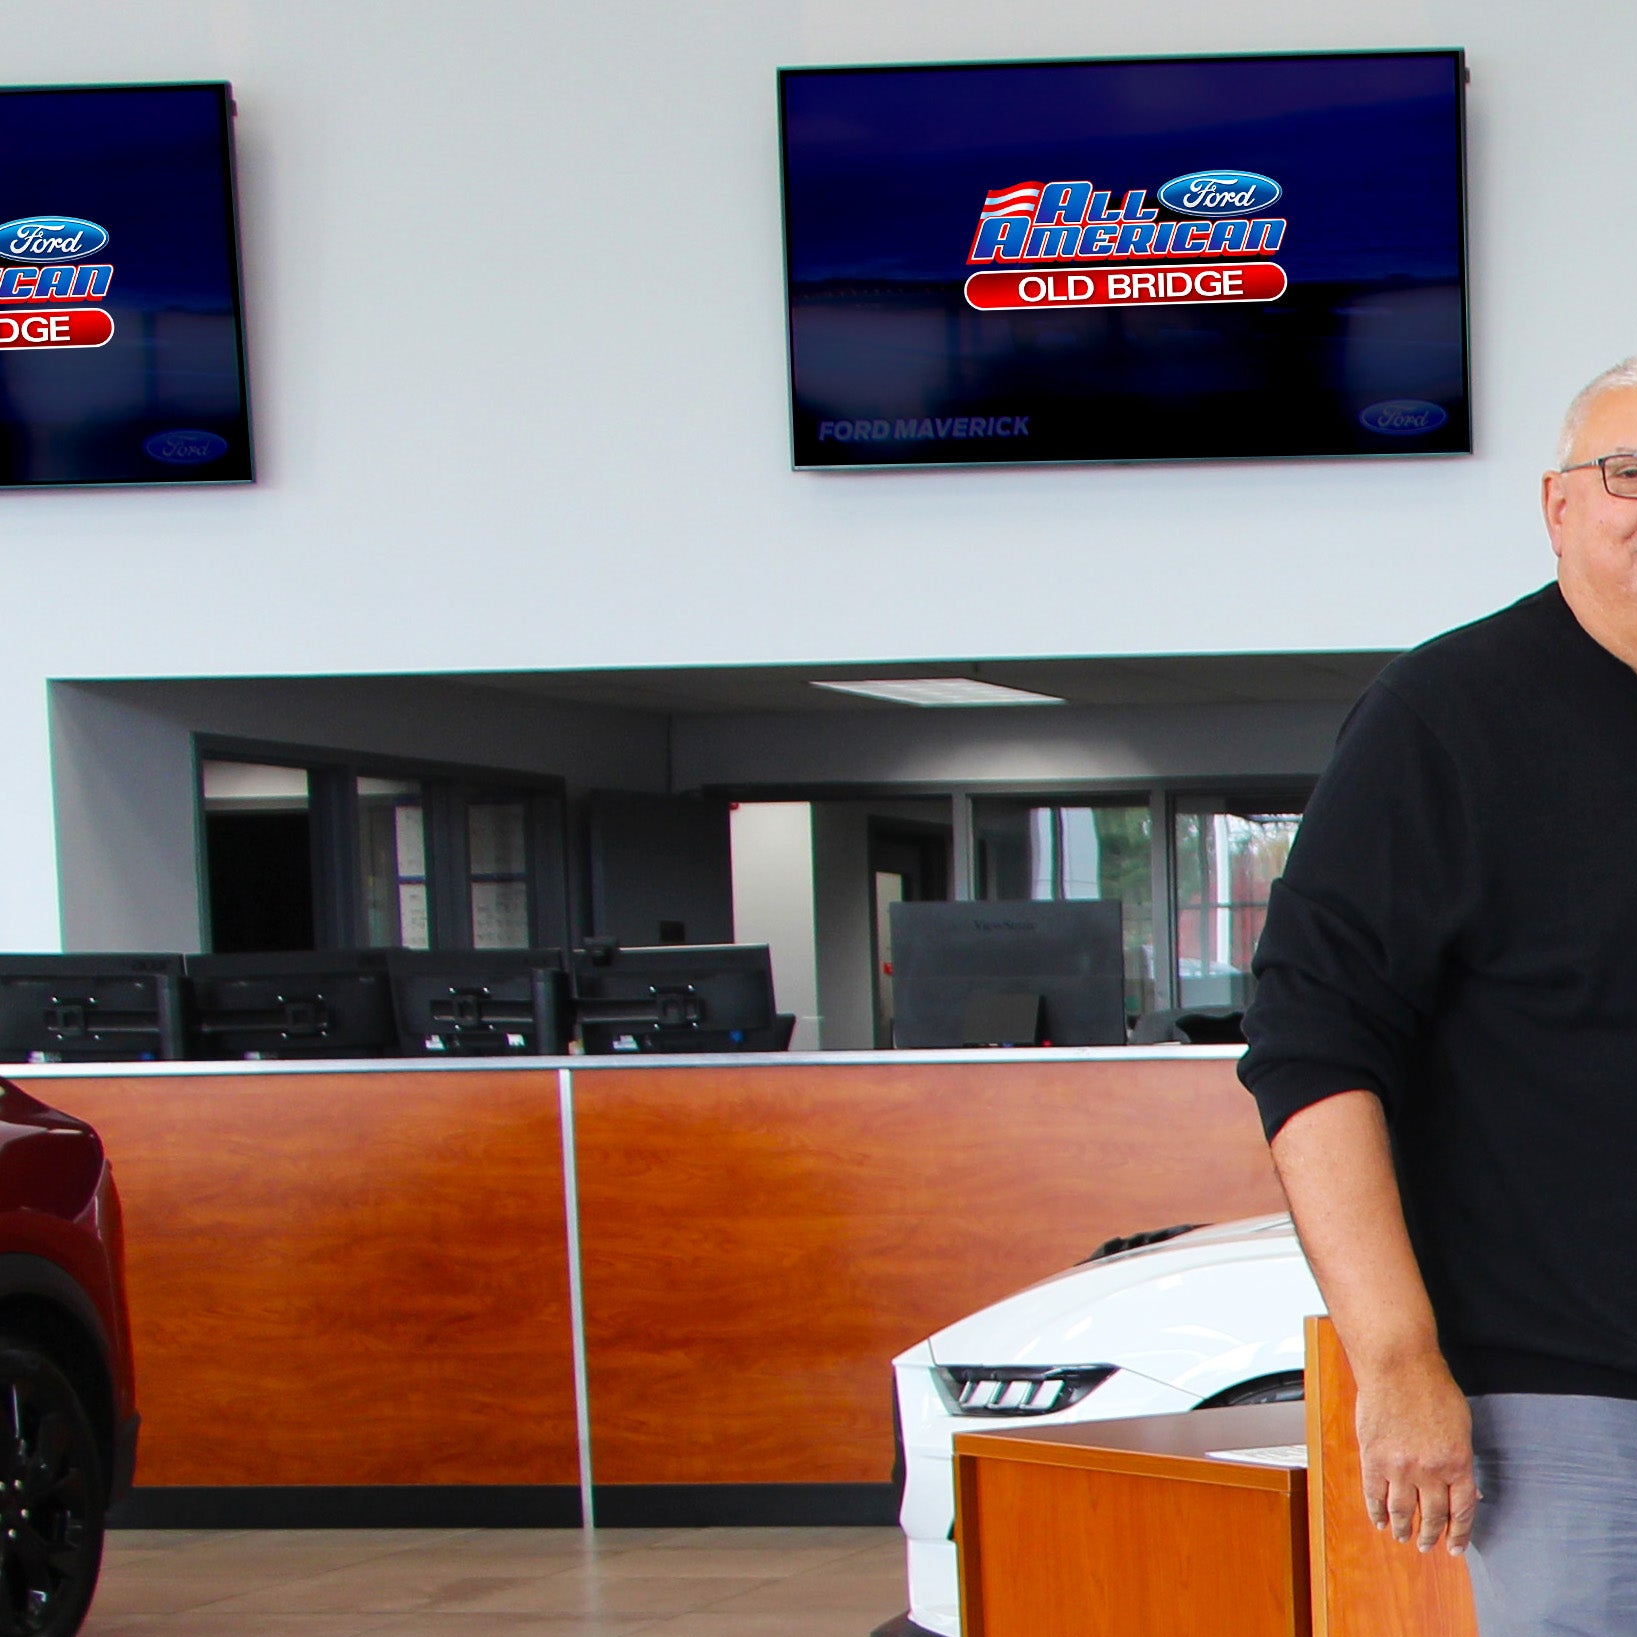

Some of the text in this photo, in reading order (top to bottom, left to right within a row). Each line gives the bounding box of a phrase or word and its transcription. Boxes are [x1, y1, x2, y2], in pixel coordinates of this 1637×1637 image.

[1035, 181, 1159, 225] ALL
[1183, 178, 1255, 209] Ford
[10, 224, 84, 254] Ford
[968, 215, 1286, 263] AMERICAN
[0, 264, 114, 303] CAN
[1018, 270, 1244, 302] OLD BRIDGE
[818, 416, 1031, 441] FORD MAVERICK
[1377, 405, 1430, 427] Ford
[162, 434, 211, 457] Ford
